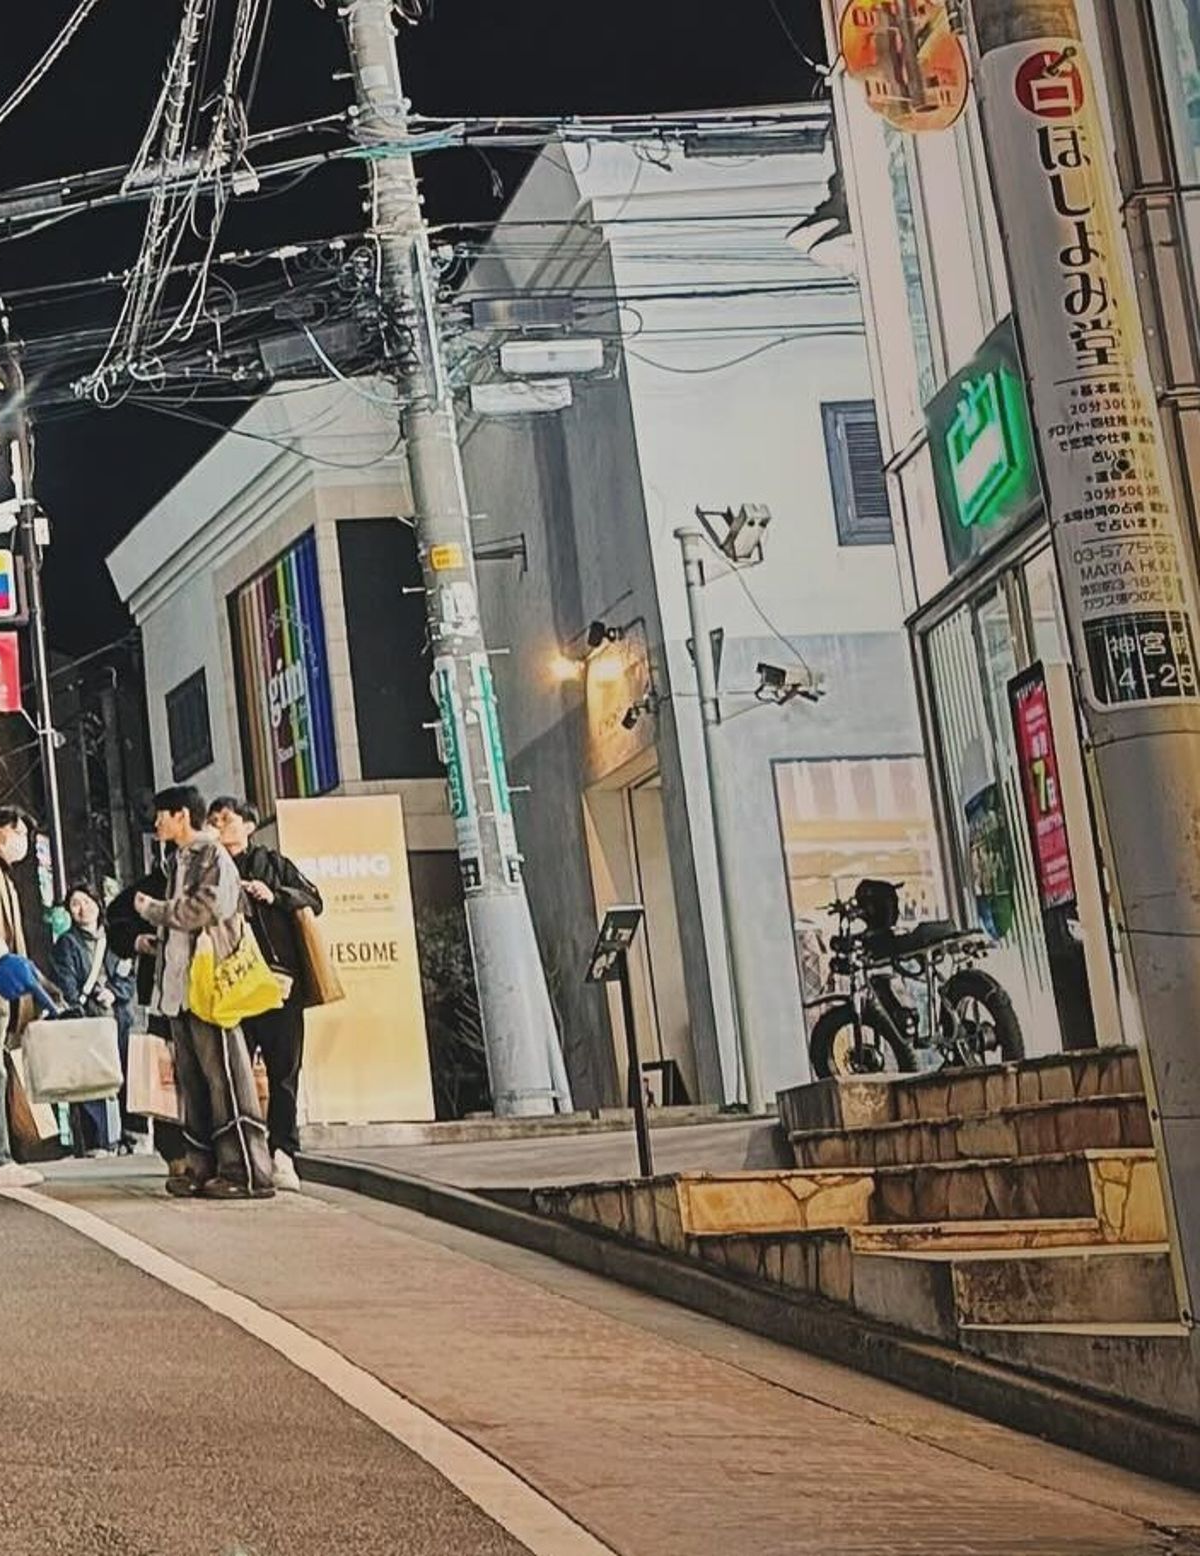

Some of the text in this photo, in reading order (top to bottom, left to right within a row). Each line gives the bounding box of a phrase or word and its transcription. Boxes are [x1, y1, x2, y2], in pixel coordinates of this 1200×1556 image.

[1081, 559, 1135, 581] MARIA
[1119, 663, 1194, 691] 4-25
[329, 940, 399, 962] ESOME
